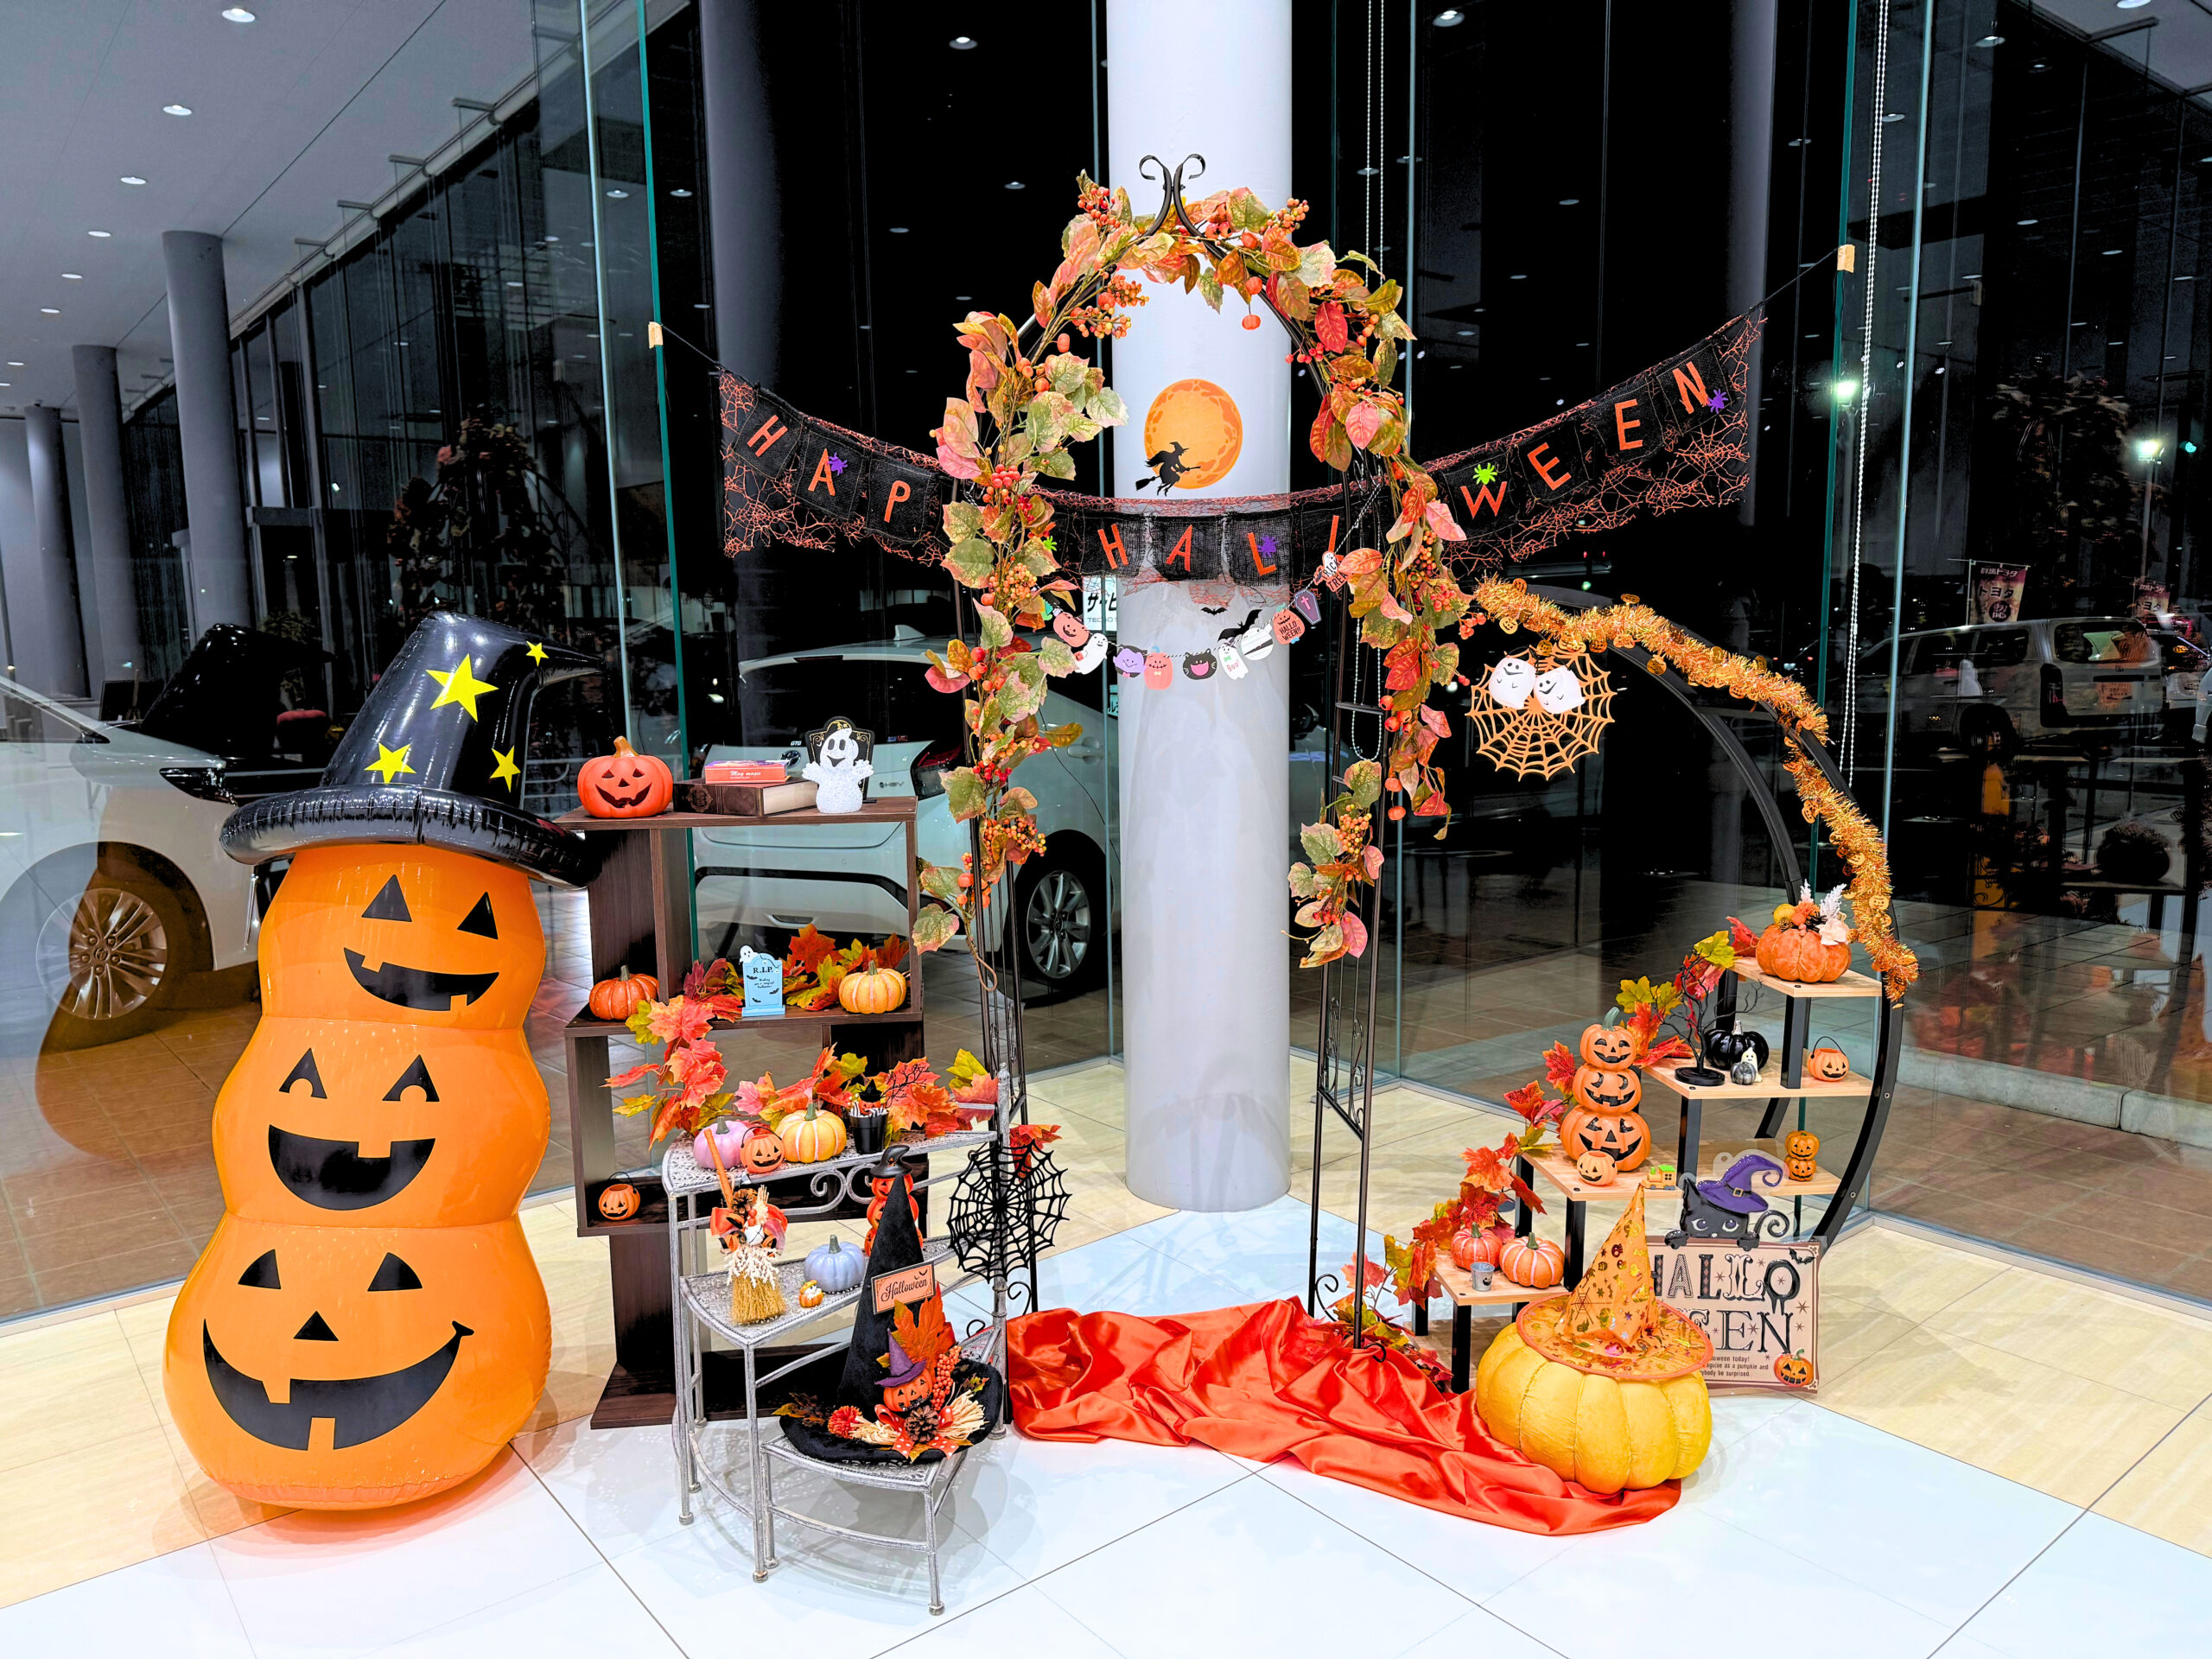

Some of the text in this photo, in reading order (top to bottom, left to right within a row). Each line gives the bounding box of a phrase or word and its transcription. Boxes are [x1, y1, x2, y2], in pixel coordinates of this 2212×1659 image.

[1328, 572, 1349, 591] TREA
[1979, 585, 2014, 598] トヨタ
[1279, 620, 1298, 635] HALLO
[880, 1279, 928, 1302] Halloween
